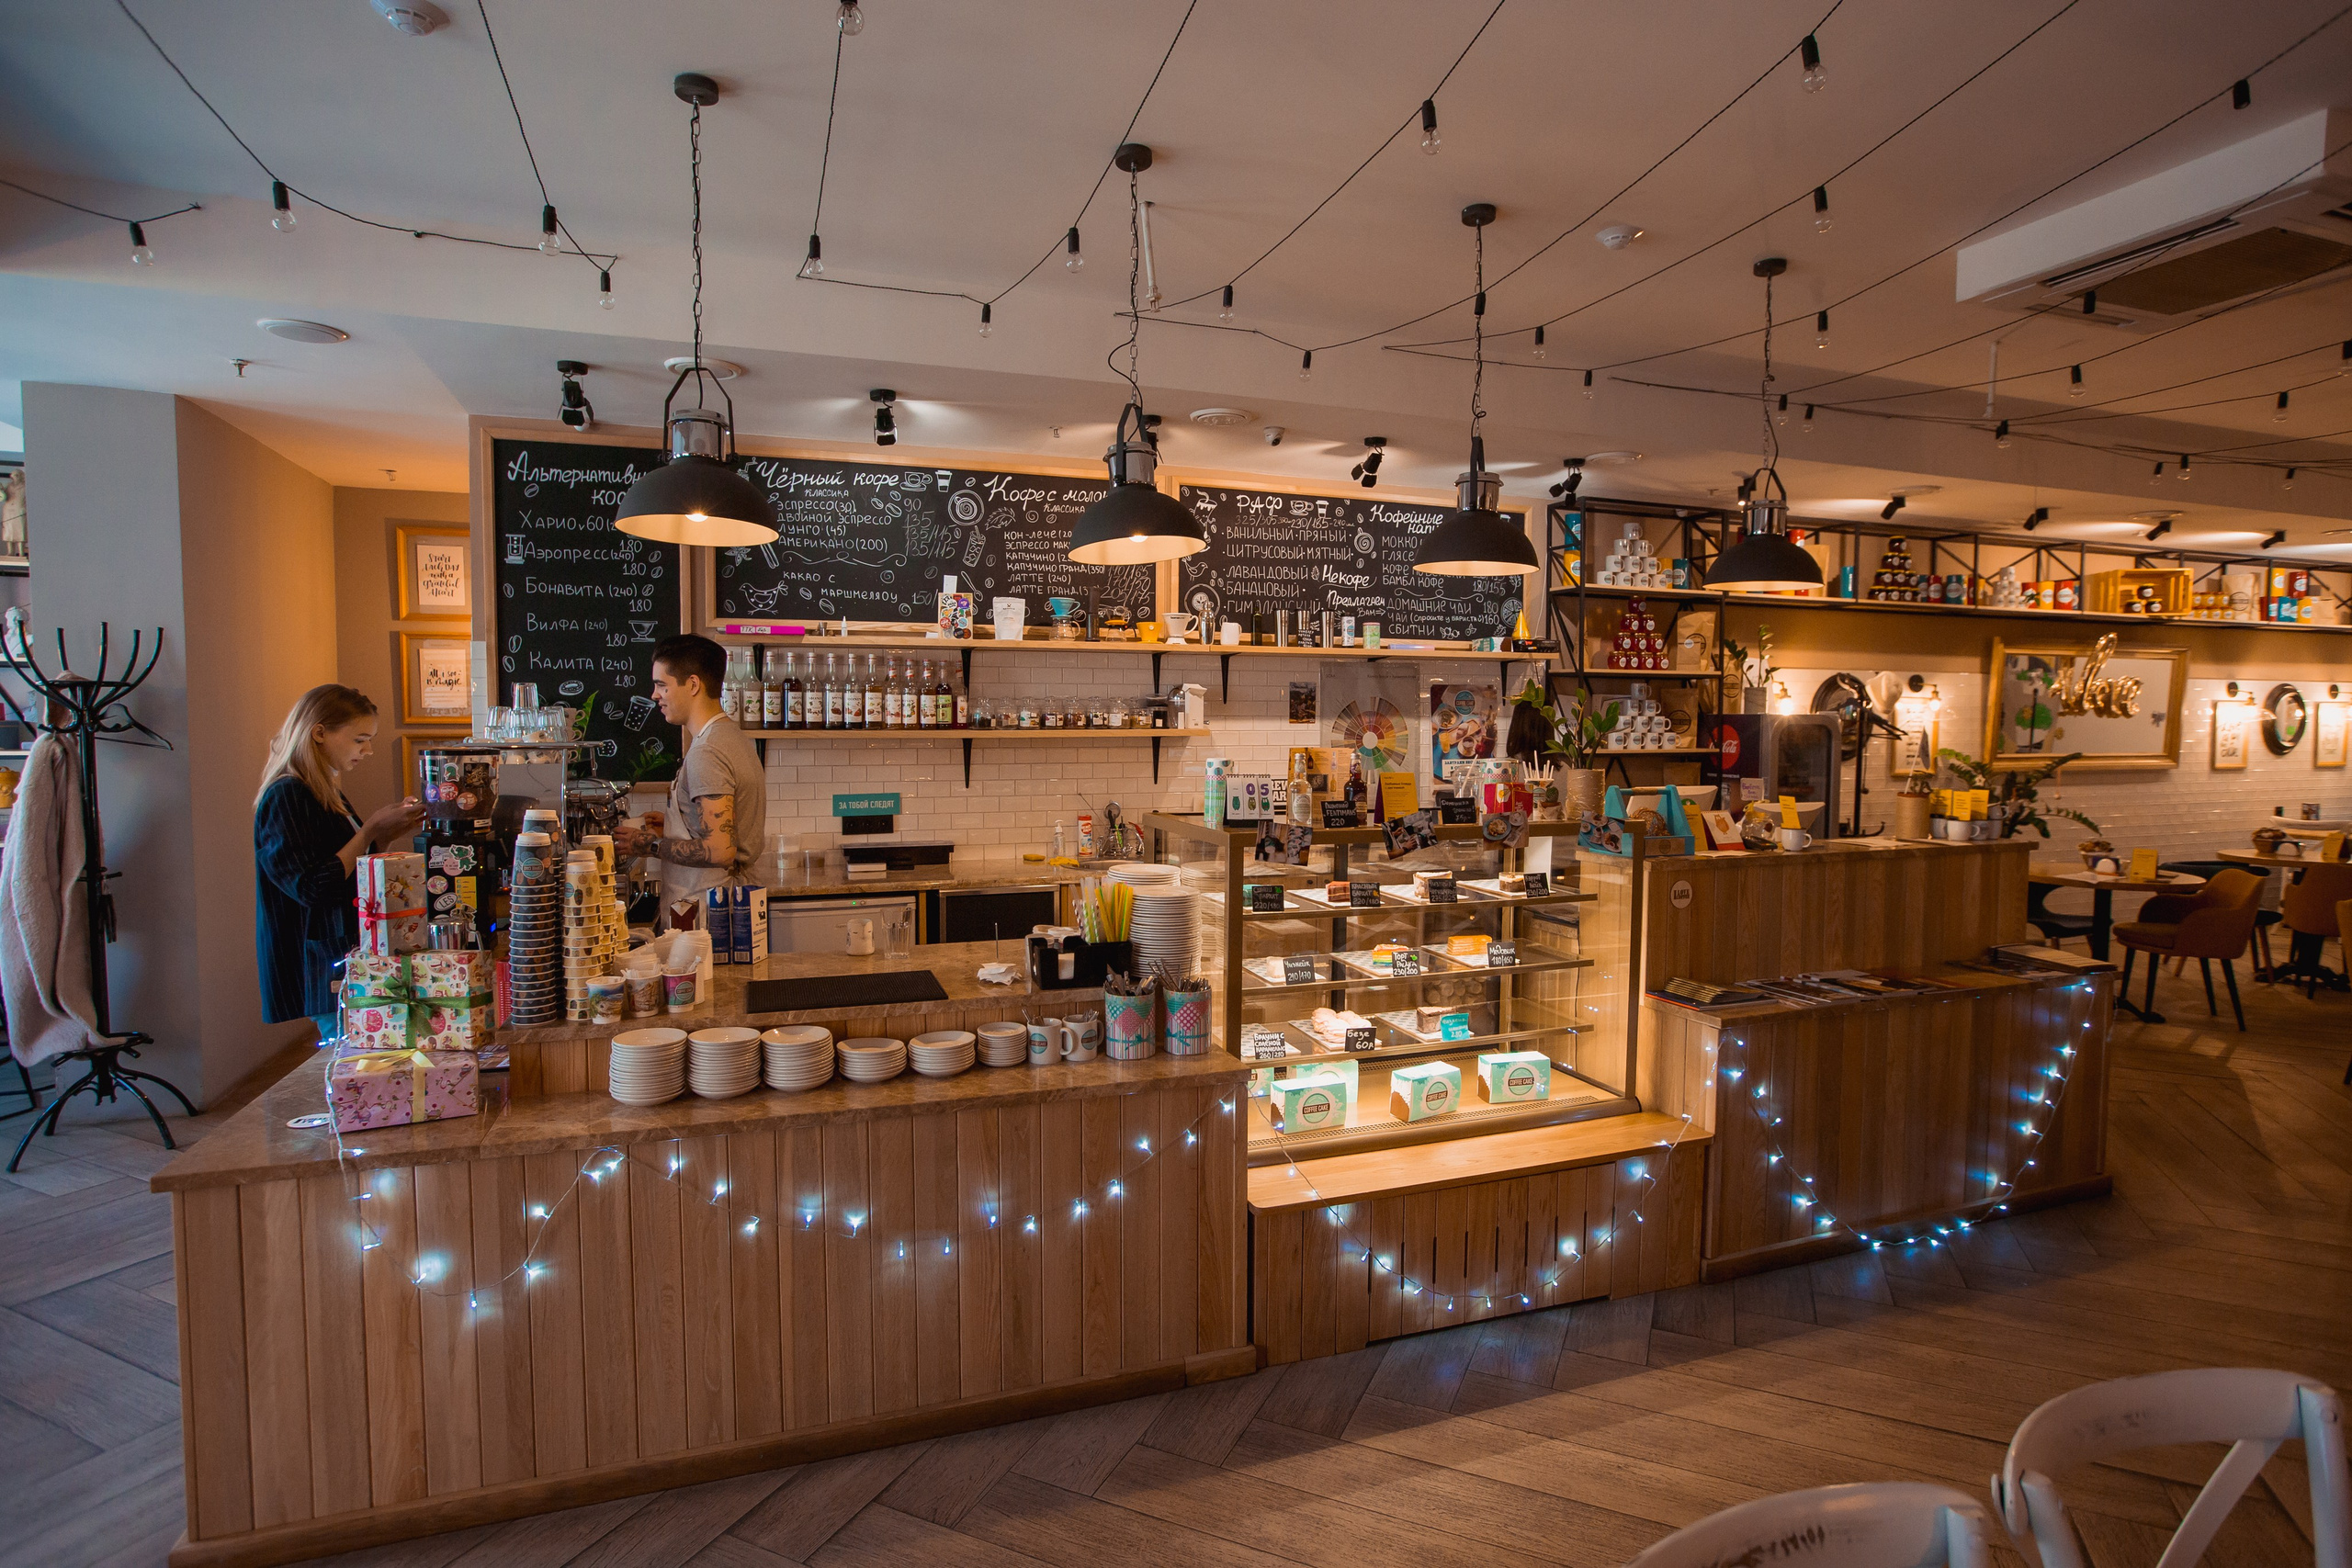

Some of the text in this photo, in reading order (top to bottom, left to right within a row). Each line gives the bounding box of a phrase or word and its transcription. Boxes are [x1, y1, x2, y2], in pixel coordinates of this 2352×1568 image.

[507, 450, 647, 489] Альтернативн
[755, 461, 899, 493] Чёрный кофе
[904, 498, 922, 513] 90
[1236, 494, 1283, 515] РАФ
[1370, 504, 1443, 527] Кофейные
[826, 525, 846, 536] (45)
[1227, 525, 1347, 542] ВАНИЛЬНЫЙ ПРЯНЫЙ
[619, 540, 643, 553] 180
[1382, 536, 1418, 548] МОККО
[1227, 544, 1351, 561] ЦИТРУСОВЫЙ МЯТНЫЙ
[623, 562, 646, 576] 180
[1226, 565, 1308, 580] ЛАВАНДОВЫЙ
[1008, 573, 1044, 582] ЛАТТЕ
[1048, 574, 1071, 584] (240)
[1383, 575, 1415, 586] БАМБЛ
[608, 583, 638, 597] (240)
[1009, 585, 1044, 594] ЛАТТЕ
[1227, 581, 1299, 597] БАНАНОВЫЙ
[629, 599, 651, 612] 180
[1483, 602, 1498, 614] 180
[584, 618, 608, 631] (240)
[1485, 615, 1499, 625] 160
[1388, 624, 1434, 636] СБИТНИ
[605, 634, 627, 647] 180
[601, 657, 633, 671] (240)
[615, 675, 636, 687] 180
[848, 800, 868, 809] ТОБОЙ
[870, 800, 895, 809] СЛЕДЯТ
[1331, 818, 1345, 826] 220
[438, 896, 455, 908] LES
[1348, 1030, 1370, 1040] Безе
[1317, 1103, 1329, 1112] CAKE
